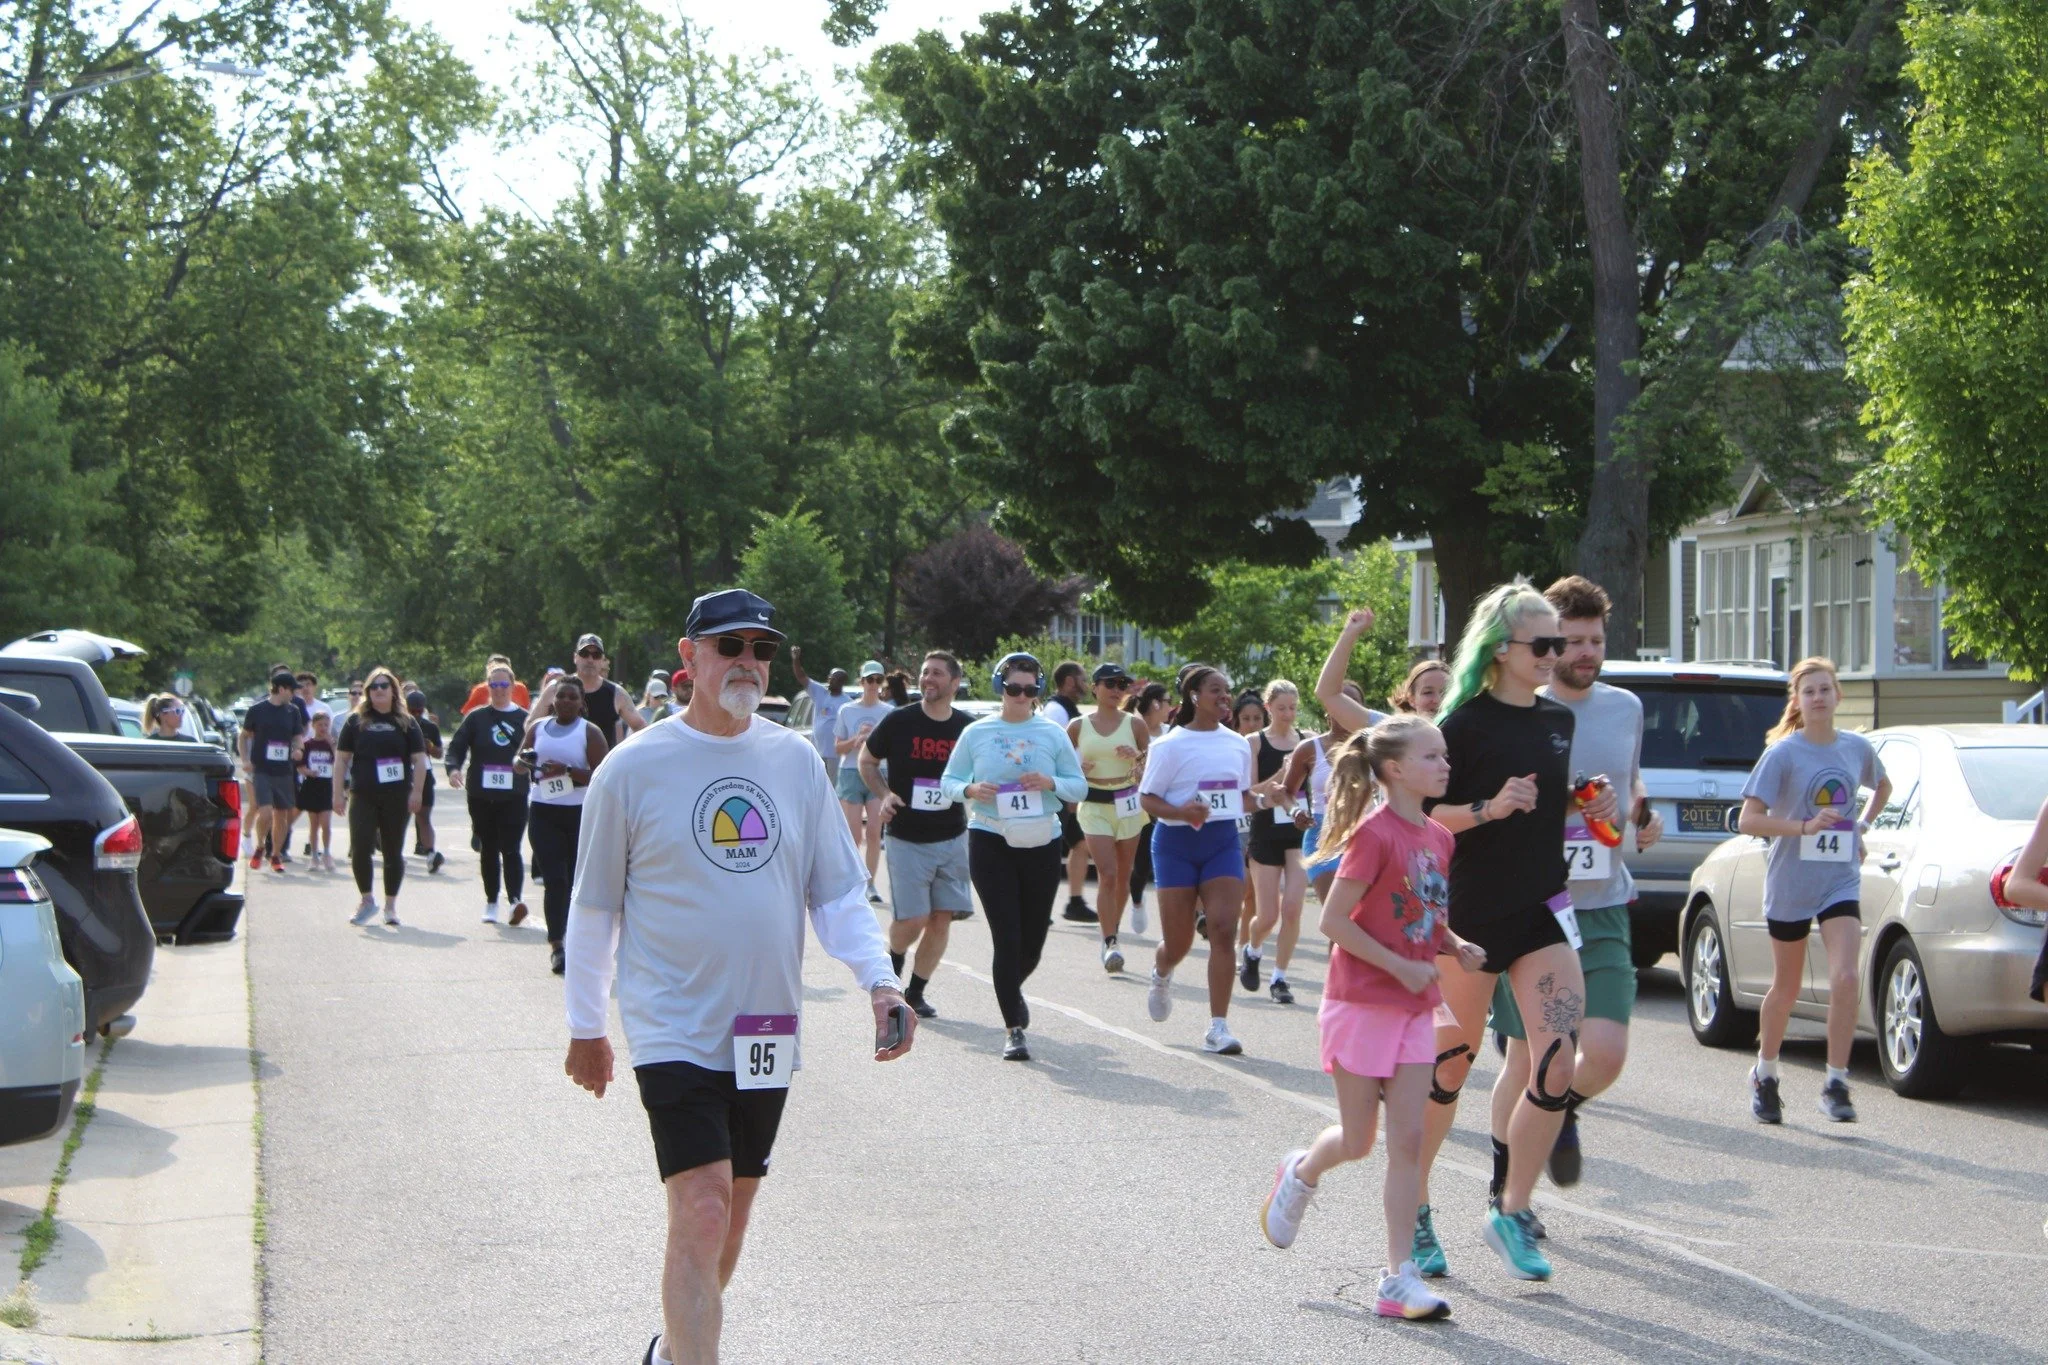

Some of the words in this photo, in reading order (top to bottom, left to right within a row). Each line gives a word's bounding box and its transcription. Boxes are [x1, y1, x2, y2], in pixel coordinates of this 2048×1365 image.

[386, 766, 399, 778] 96
[492, 774, 505, 785] 98
[548, 779, 564, 793] 39
[924, 790, 942, 805] 32
[1011, 795, 1029, 810] 41
[1211, 793, 1227, 810] 51
[698, 792, 715, 833] Juneteenth
[713, 782, 745, 795] Freedom
[745, 786, 755, 794] 5K
[756, 792, 776, 829] Walk/Run
[1816, 834, 1840, 853] 44
[725, 847, 757, 859] MAM
[1566, 846, 1594, 870] 73
[735, 861, 751, 869] 2024
[750, 1043, 776, 1076] 95
